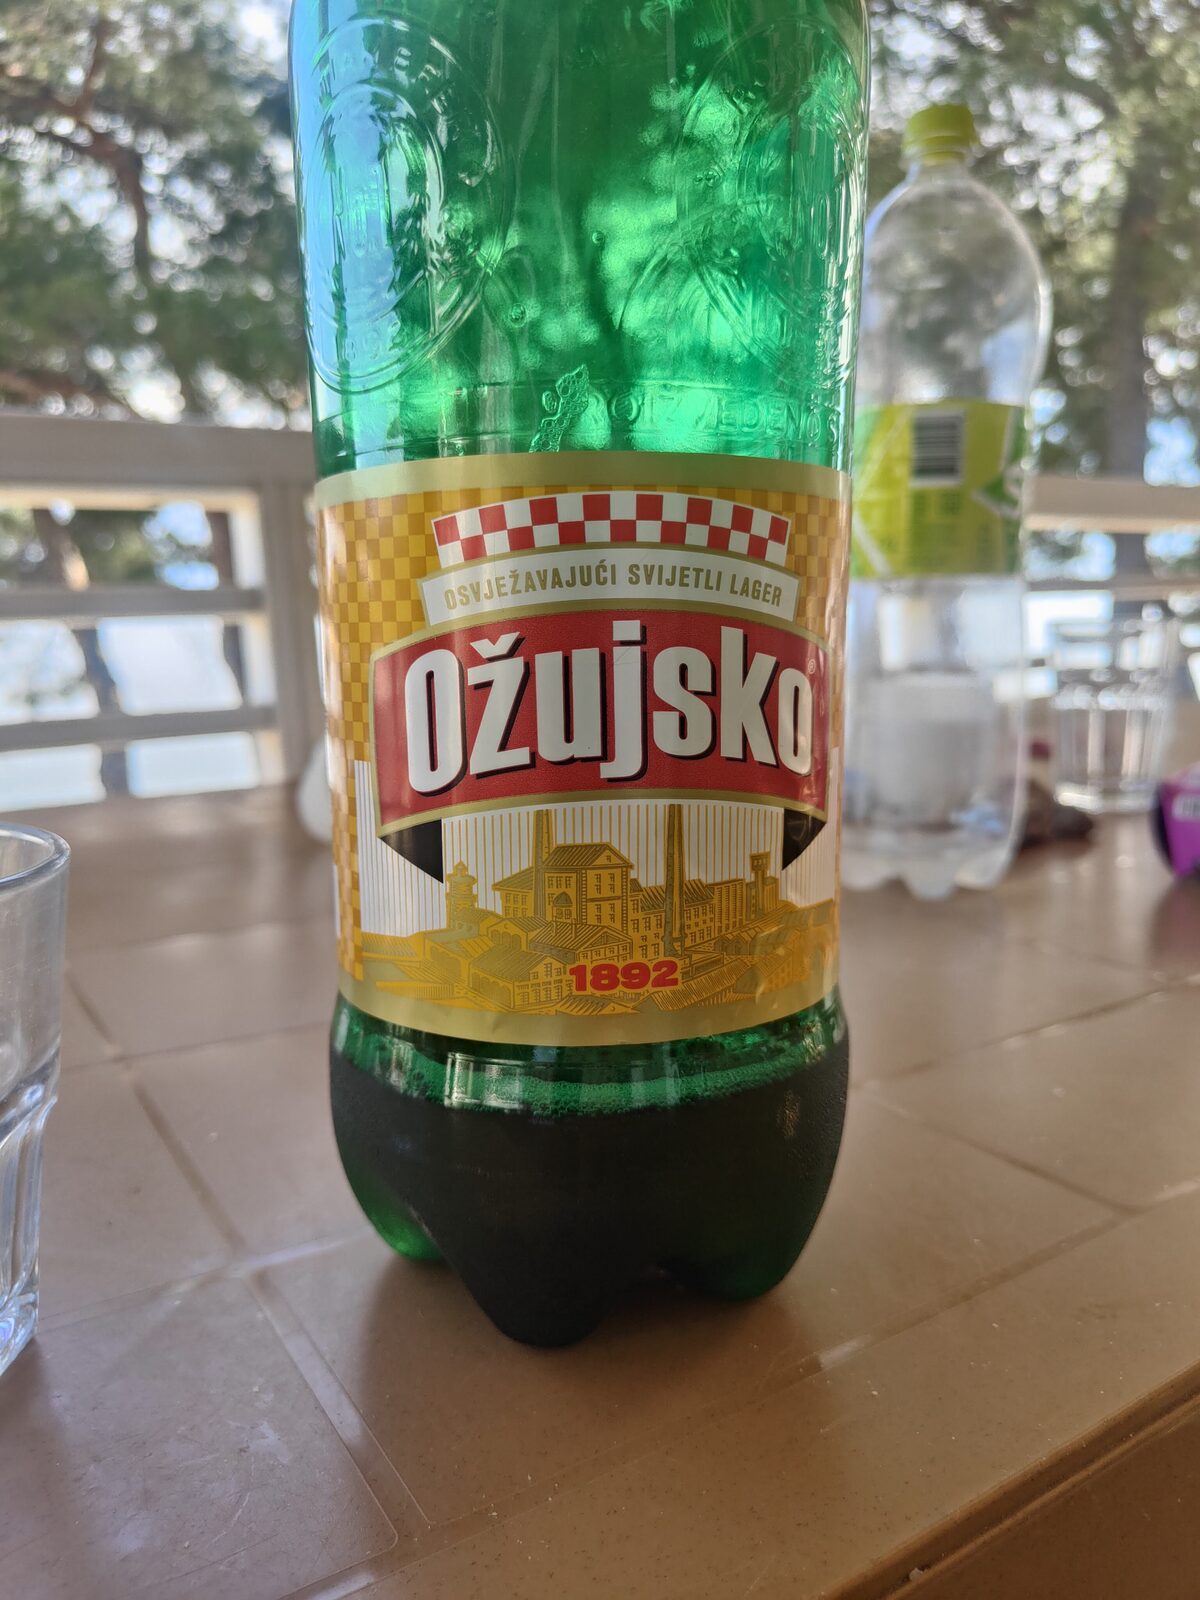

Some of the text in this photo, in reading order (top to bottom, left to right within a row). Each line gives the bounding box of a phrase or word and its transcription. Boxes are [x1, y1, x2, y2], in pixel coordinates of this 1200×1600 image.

[443, 559, 783, 611] OSVJEŽAVAJUĆI SVIJETLI LAGER
[403, 619, 814, 796] Ožujsko
[568, 960, 680, 992] 1892
